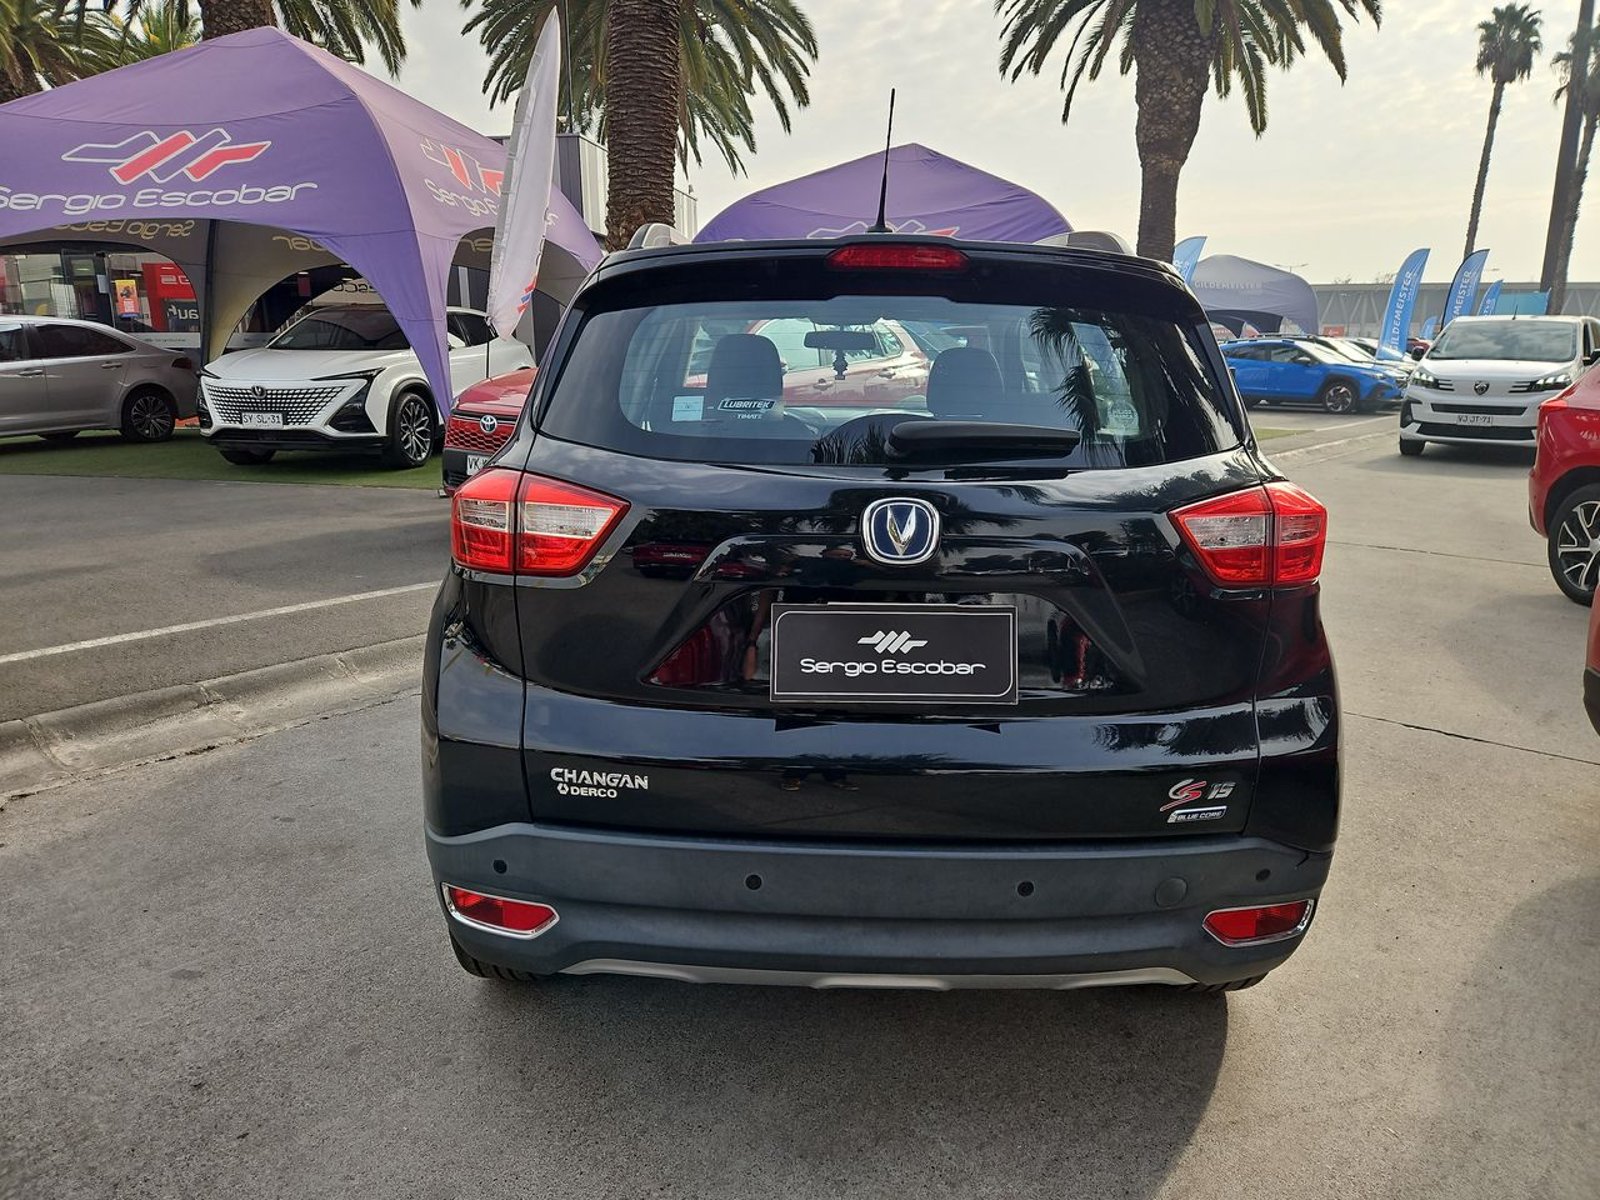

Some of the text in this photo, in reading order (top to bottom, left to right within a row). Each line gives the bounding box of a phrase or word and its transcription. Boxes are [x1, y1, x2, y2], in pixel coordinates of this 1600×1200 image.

[132, 182, 318, 207] Escobar
[1388, 270, 1413, 351] GILDEMEISTER
[723, 399, 770, 409] LUBRITEK
[799, 658, 986, 677] Sergio Escobar
[550, 767, 648, 789] CHANGAN
[570, 786, 618, 798] DERCO
[1200, 811, 1222, 819] CORE
